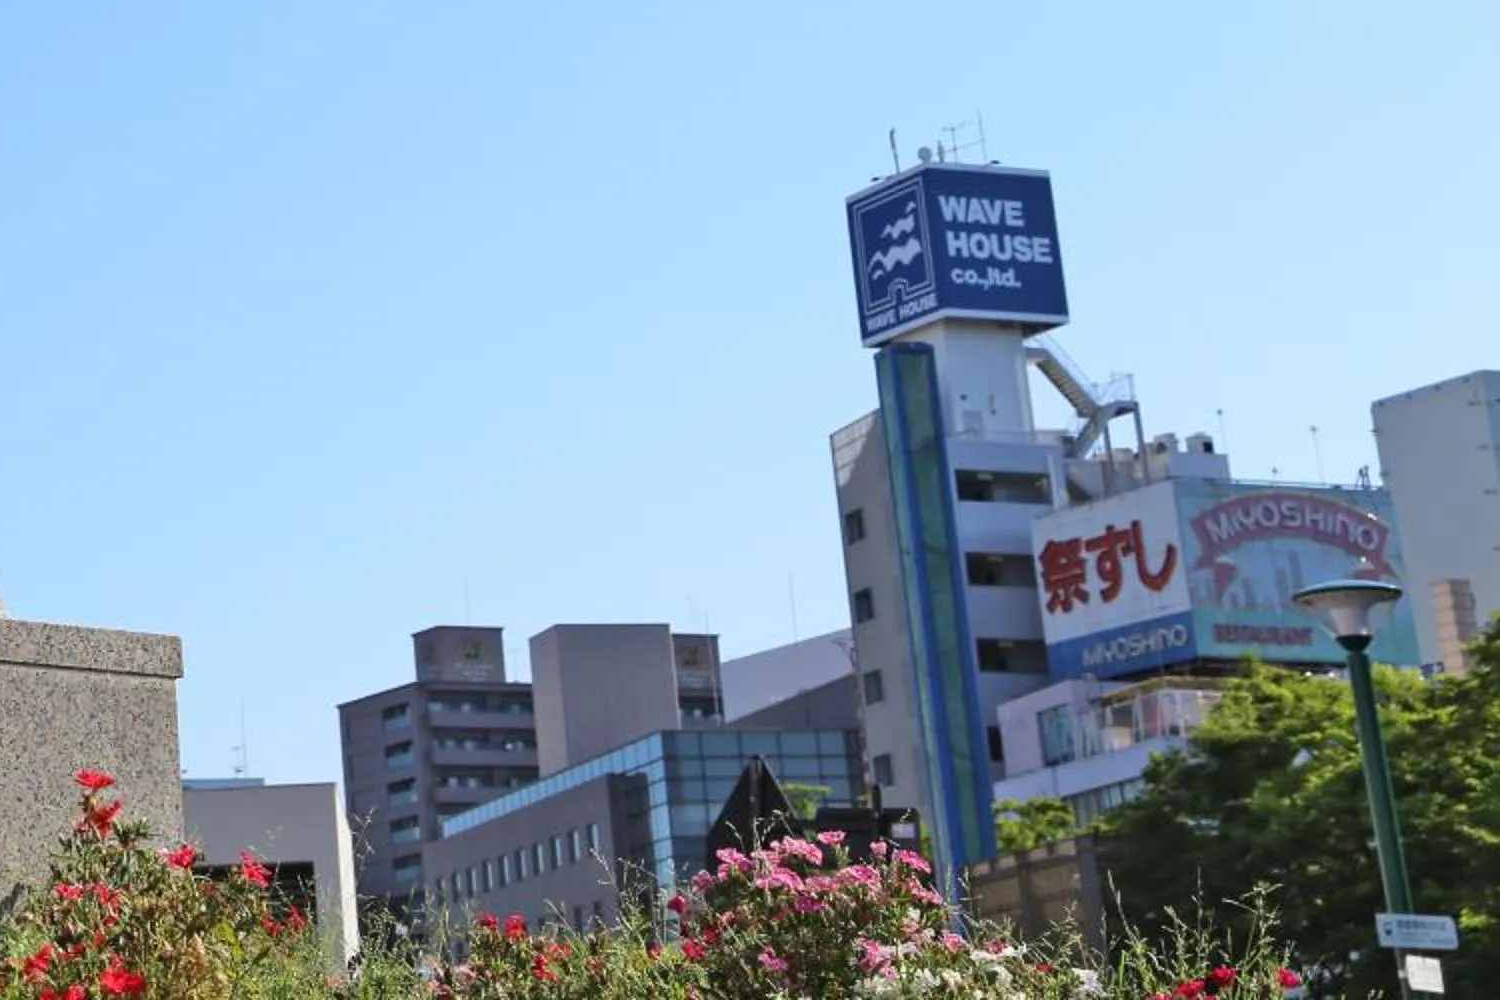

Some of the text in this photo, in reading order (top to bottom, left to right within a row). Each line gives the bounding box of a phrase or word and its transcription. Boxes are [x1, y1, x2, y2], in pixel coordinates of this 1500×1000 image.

[938, 195, 1024, 227] WAVE
[945, 231, 1053, 263] HOUSE
[866, 293, 938, 332] WAVE HOUSE
[1205, 500, 1379, 550] MIYOSHINO
[1082, 624, 1187, 666] MIYOSHINO
